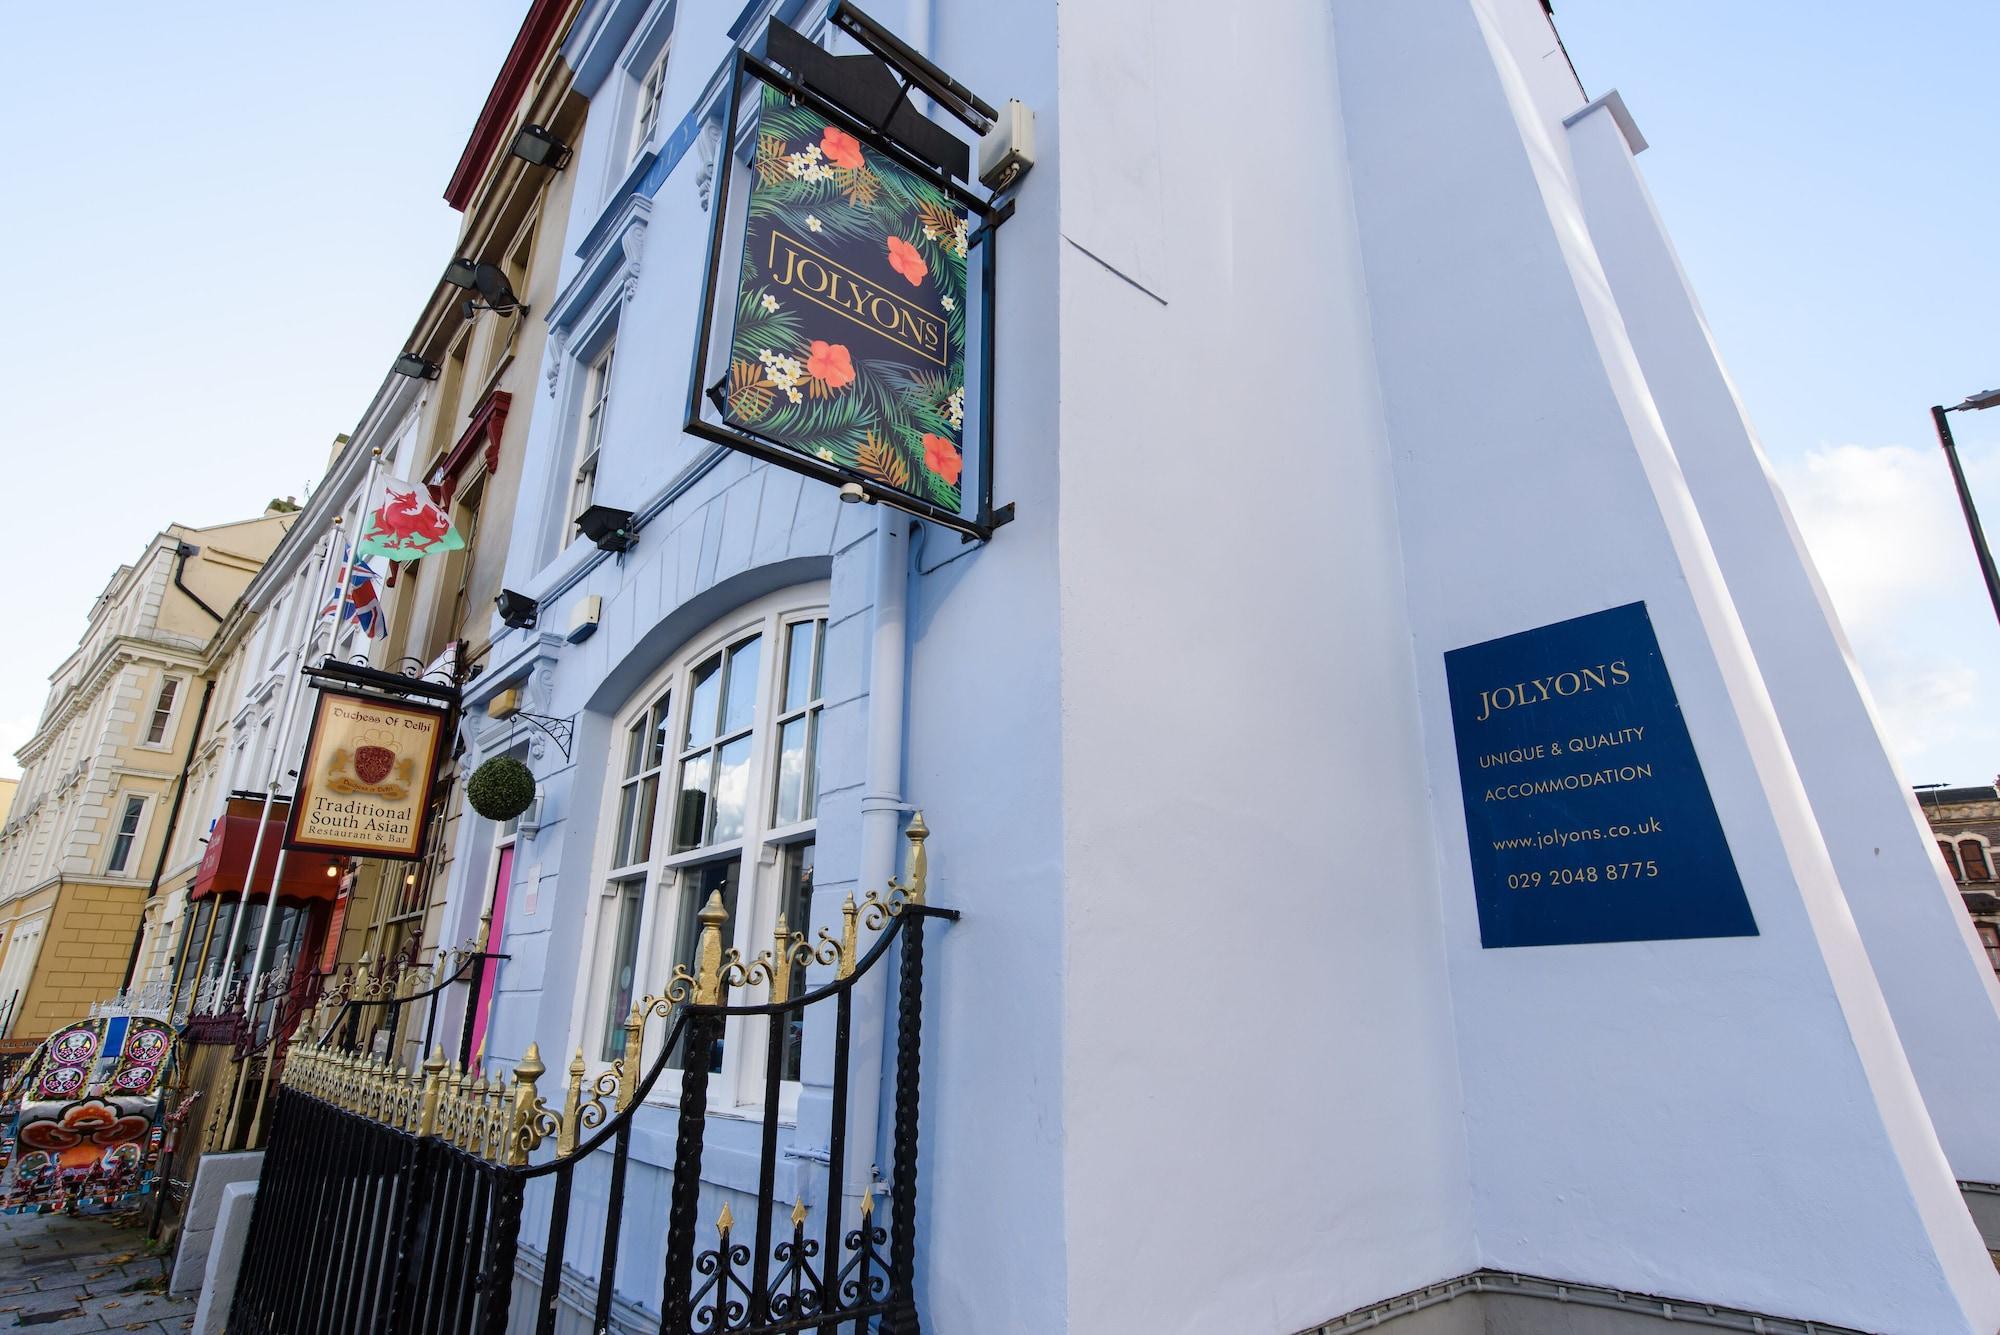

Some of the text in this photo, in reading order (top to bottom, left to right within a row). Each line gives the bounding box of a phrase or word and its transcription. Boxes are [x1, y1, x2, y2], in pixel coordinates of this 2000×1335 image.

[773, 248, 938, 346] JOLYONS
[1477, 660, 1630, 721] JOLYONS
[334, 707, 432, 733] Duchess Of Delhi
[1479, 727, 1645, 768] UNIQUE & QUALITY
[1484, 764, 1652, 802] ACCOMMODATION
[310, 811, 409, 834] South Asian
[314, 796, 412, 821] Traditional
[308, 825, 371, 840] Restaurant
[388, 835, 408, 844] Bar
[1493, 817, 1663, 851] www.jolyons.co.uk
[1508, 860, 1659, 889] 029 2048 8775
